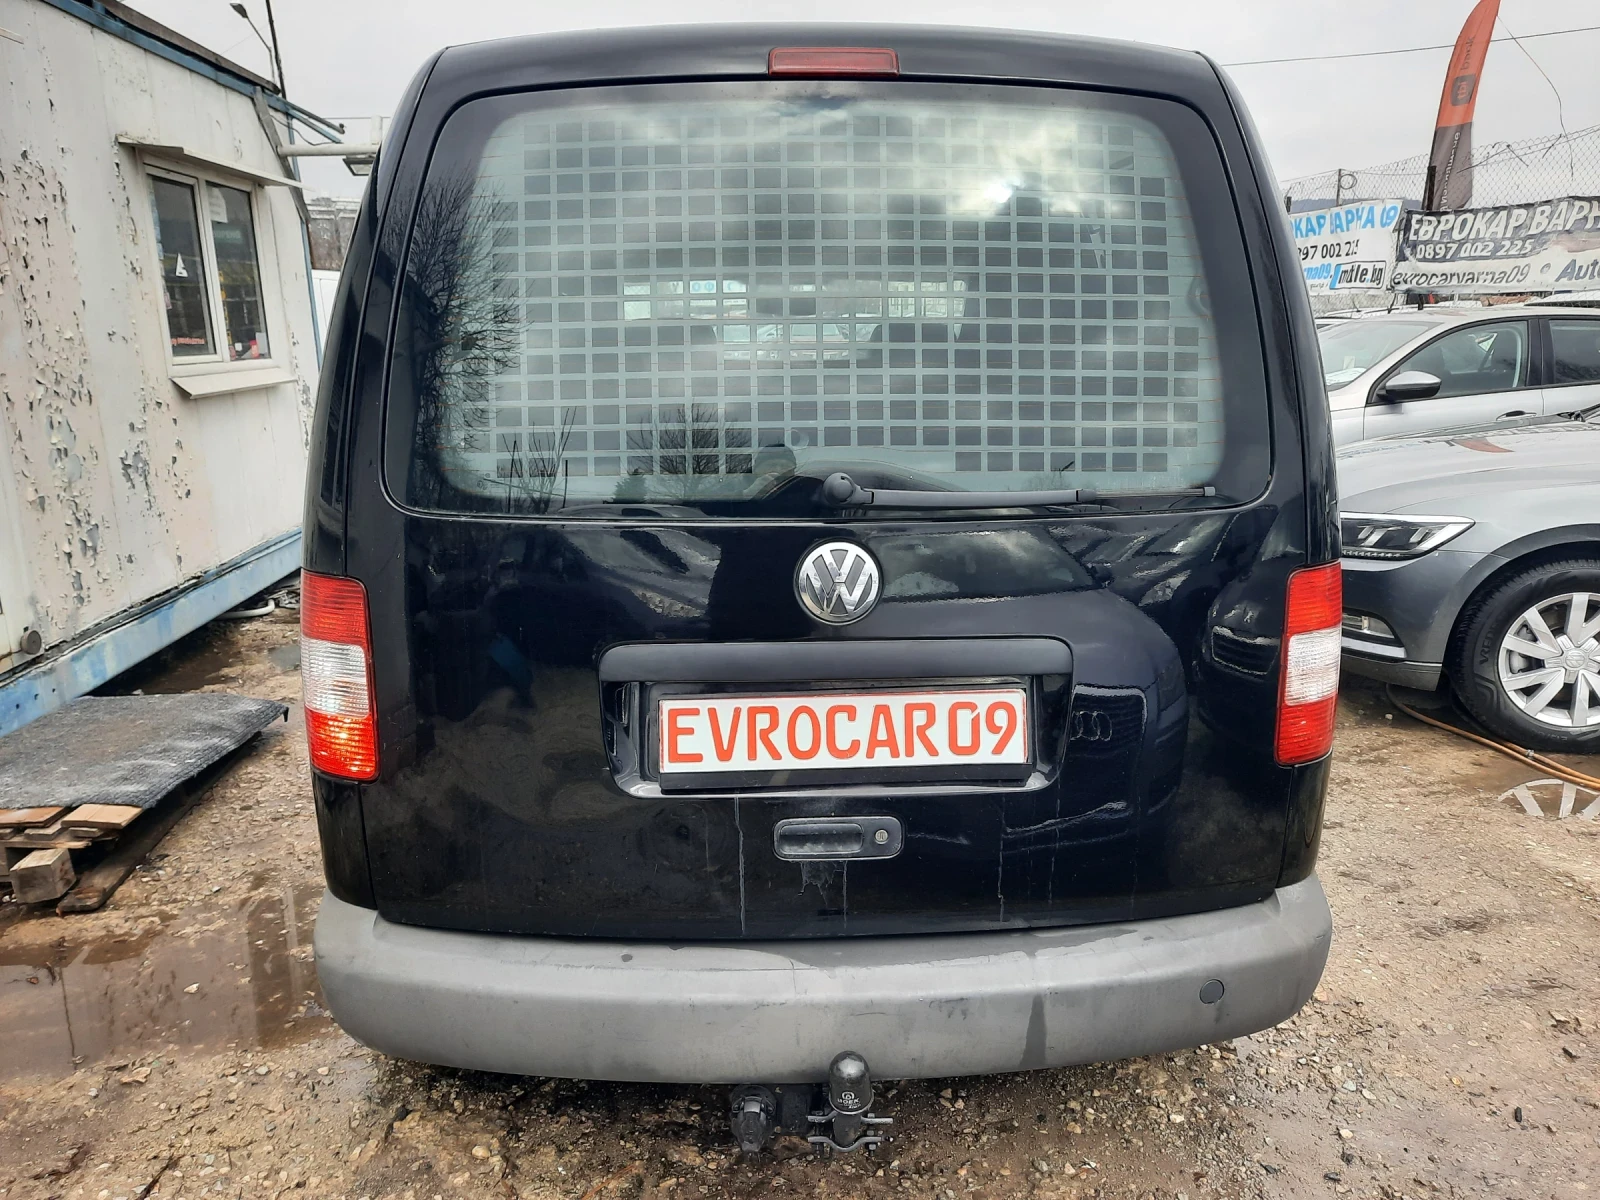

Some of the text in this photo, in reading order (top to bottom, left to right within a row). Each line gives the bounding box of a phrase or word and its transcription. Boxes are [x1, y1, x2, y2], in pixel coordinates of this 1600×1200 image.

[1292, 214, 1326, 239] КАР
[1409, 207, 1528, 241] ЕВРОКАР
[1321, 242, 1342, 259] 002
[1416, 239, 1535, 260] 0897 002 225
[667, 700, 1017, 763] EVROCAR09
